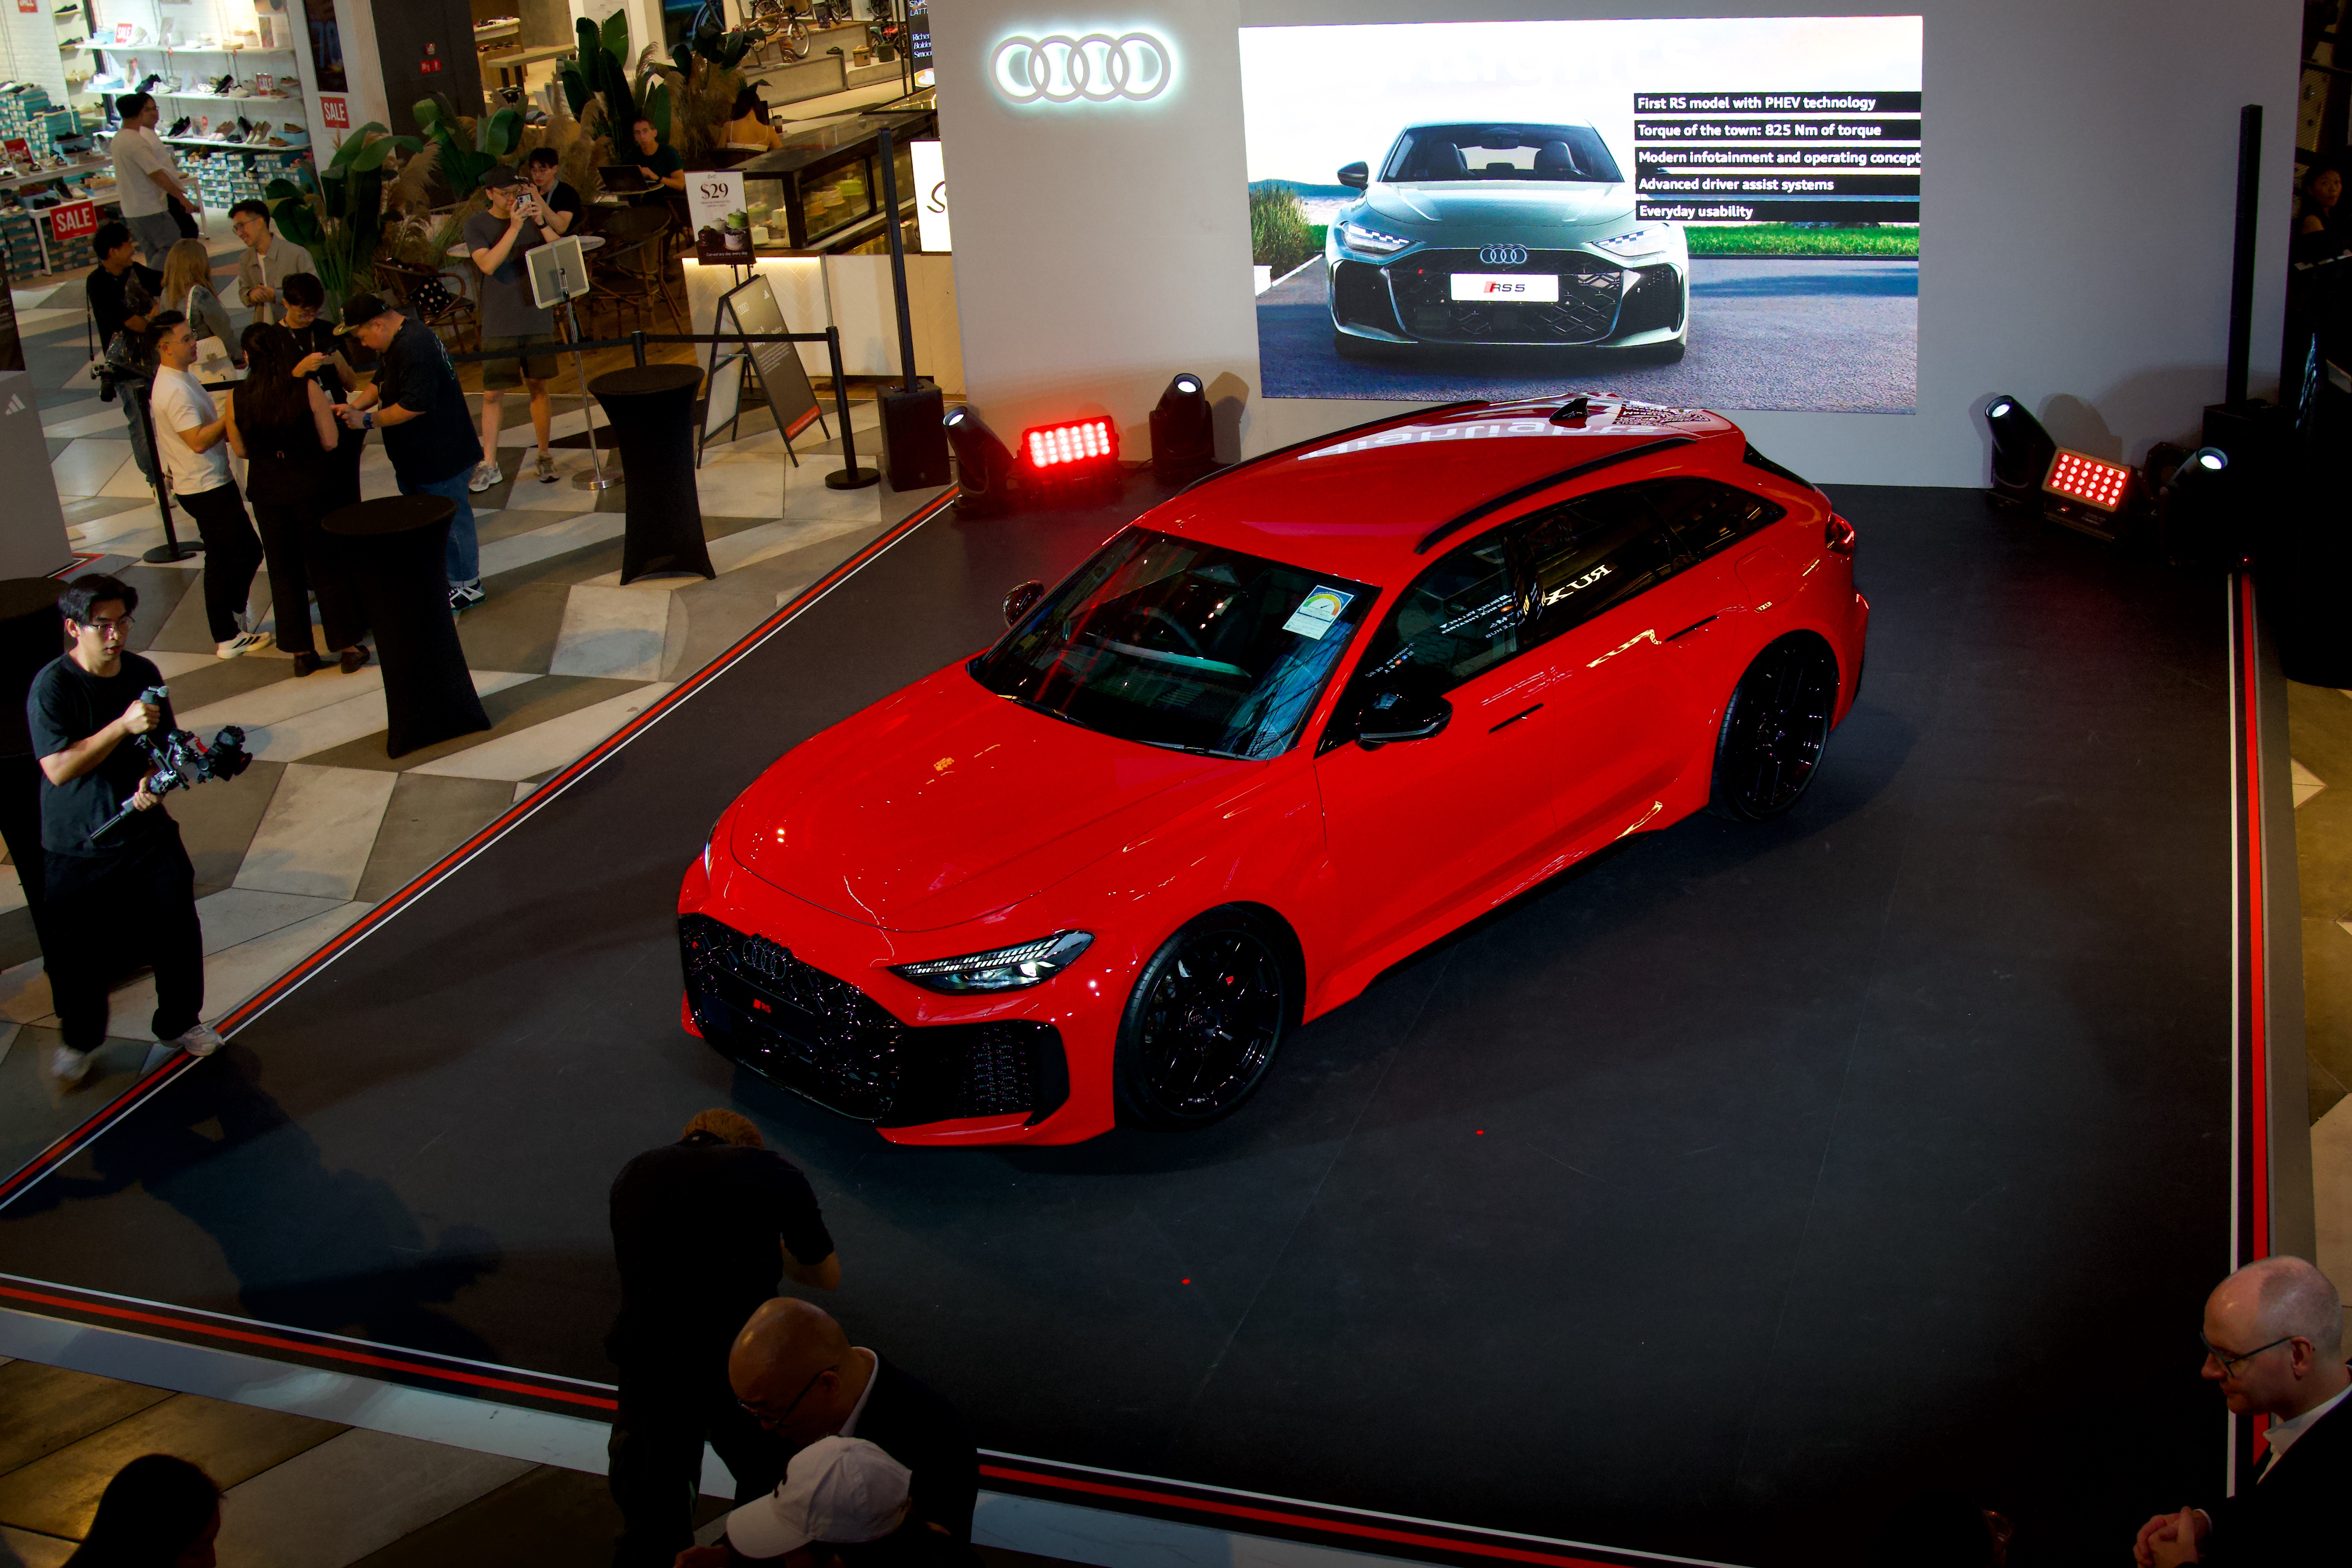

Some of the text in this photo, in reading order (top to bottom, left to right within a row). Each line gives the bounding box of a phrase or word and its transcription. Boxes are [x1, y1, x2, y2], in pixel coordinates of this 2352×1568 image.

[910, 8, 928, 17] LATT
[258, 77, 272, 90] SALE
[1638, 96, 1876, 111] First RS model with PHEV technology
[324, 102, 346, 121] SALE
[1638, 123, 1881, 139] Torque of the town: 825 Nm of torque
[1639, 151, 1921, 166] Modern infotainment and operating concept
[701, 183, 728, 200] $29
[1639, 178, 1834, 193] Advanced driver assist systems
[56, 207, 92, 232] SALE
[1640, 205, 1753, 219] Everyday usability
[1490, 283, 1512, 292] RS
[762, 1002, 771, 1013] RS
